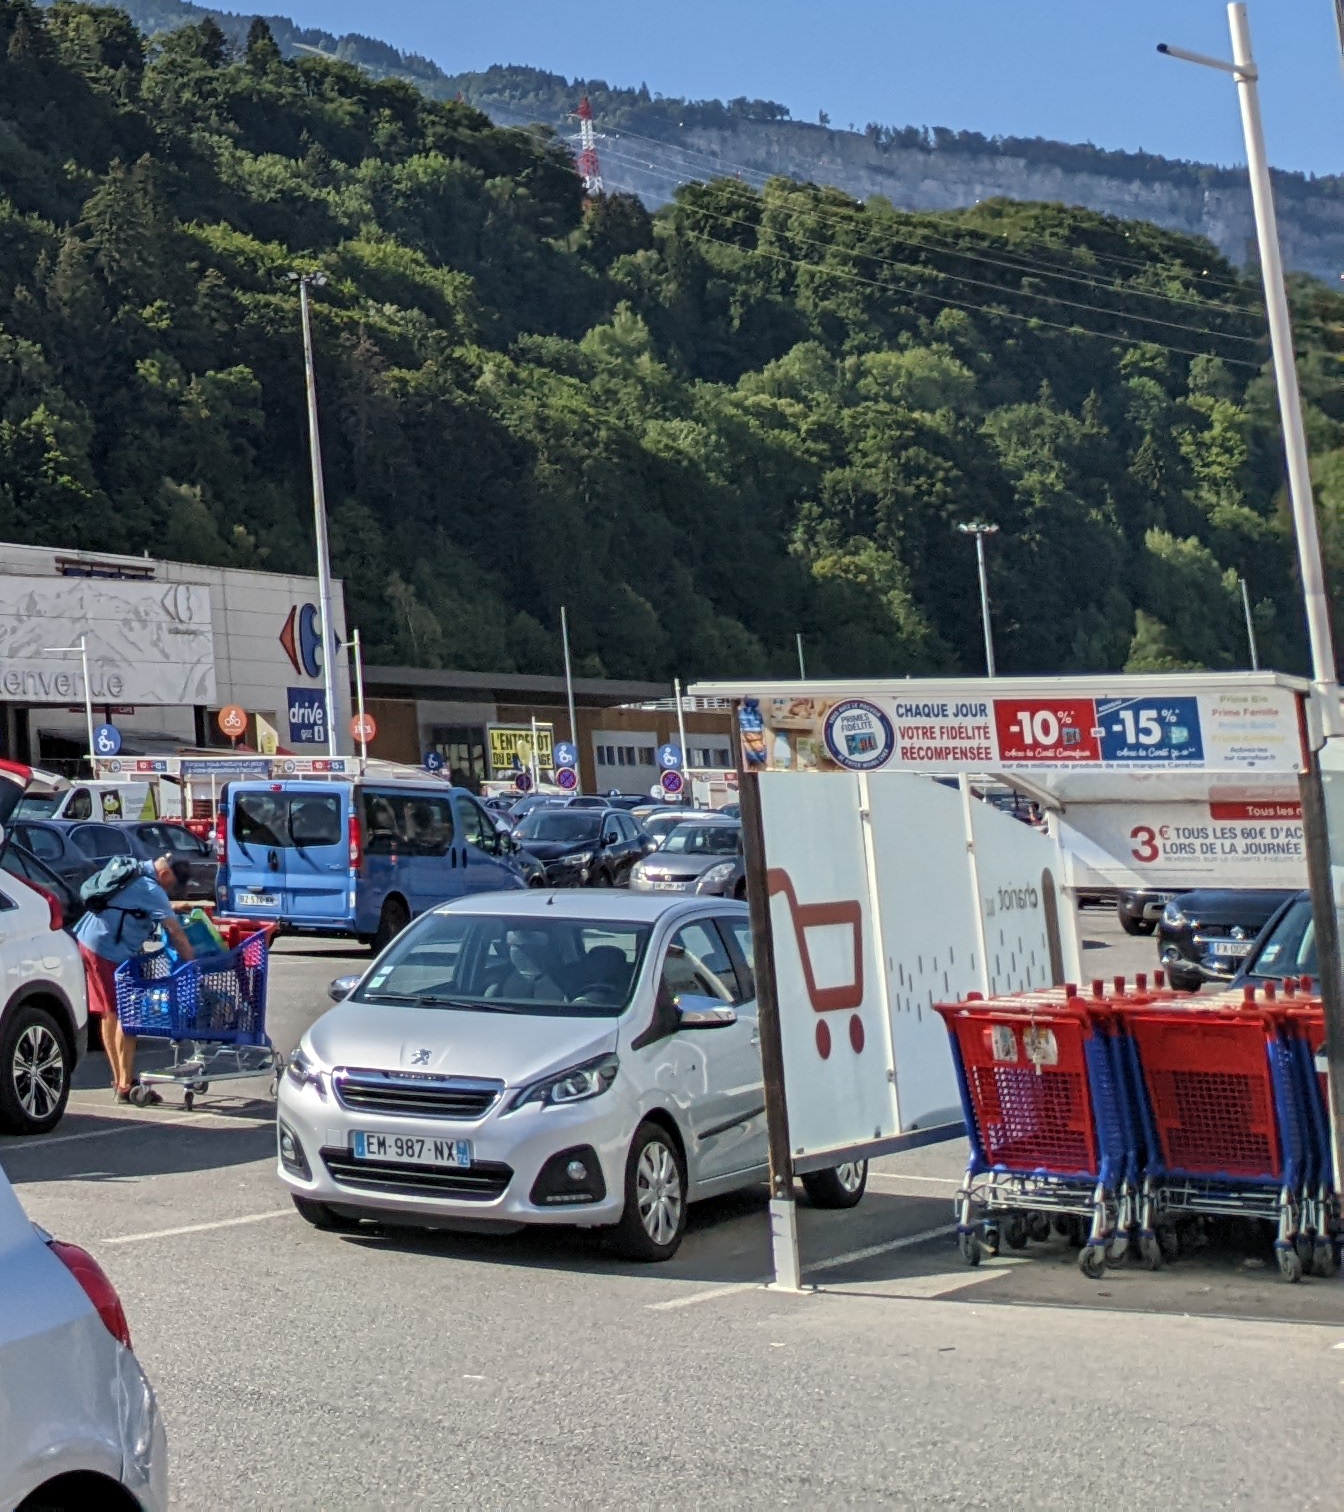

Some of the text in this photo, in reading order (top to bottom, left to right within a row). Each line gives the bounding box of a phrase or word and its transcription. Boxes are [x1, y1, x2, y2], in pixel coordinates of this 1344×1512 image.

[290, 702, 323, 724] drive
[896, 703, 988, 718] CHAQUE JOUR
[1212, 708, 1241, 717] Prime
[841, 713, 870, 724] PRIMES
[899, 724, 991, 741] VOTRE FIDÉLITÉ
[901, 743, 993, 761] RÉCOMPENSÉE
[1246, 805, 1275, 816] Tous
[1277, 805, 1294, 815] les
[1174, 827, 1209, 840] TOUS
[1213, 827, 1238, 840] LES
[1241, 826, 1267, 839] 60€
[1270, 827, 1303, 840] D'AC
[1162, 840, 1302, 855] LORS DE LA JOURNÉE
[366, 1134, 455, 1161] EM-987-NX
